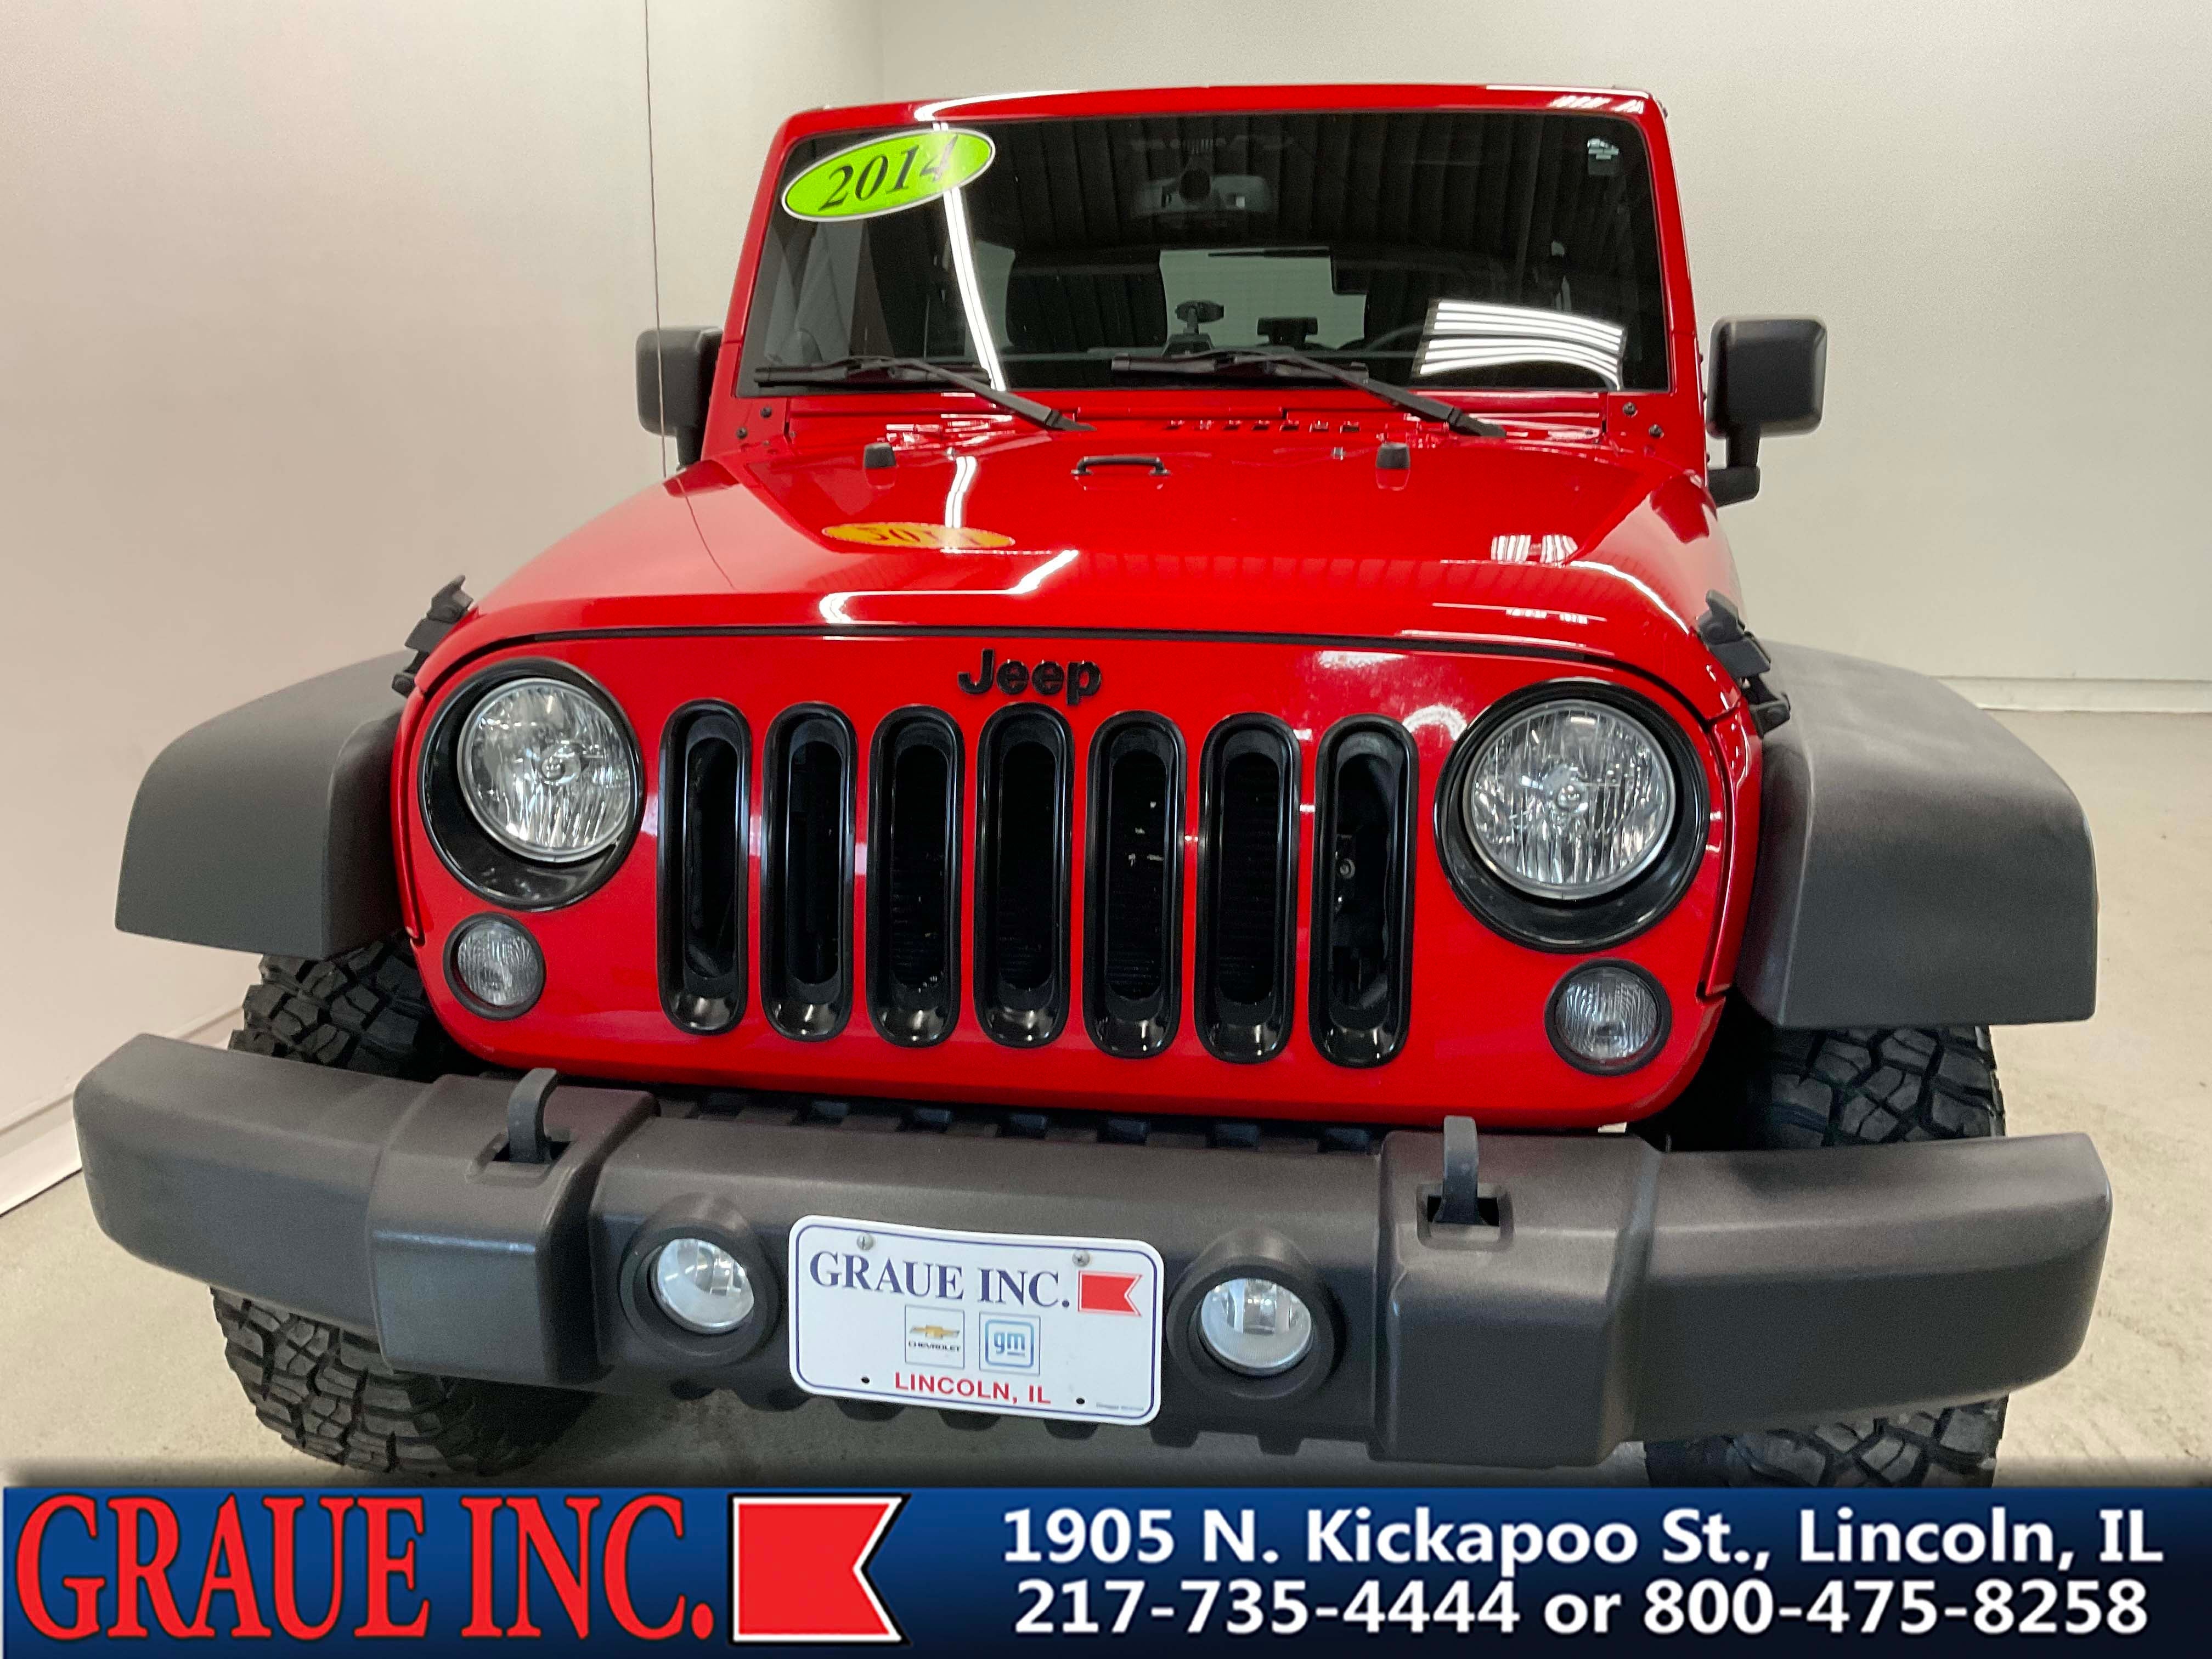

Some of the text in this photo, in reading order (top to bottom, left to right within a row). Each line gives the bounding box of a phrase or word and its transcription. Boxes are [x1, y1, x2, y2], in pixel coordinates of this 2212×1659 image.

[817, 133, 960, 212] 2014
[957, 648, 1102, 706] Jeep
[809, 1251, 1071, 1308] GRAUE INC.
[908, 1340, 961, 1352] CHEVROLET
[994, 1332, 1025, 1357] gm
[895, 1372, 1052, 1404] LINCOLN, IL
